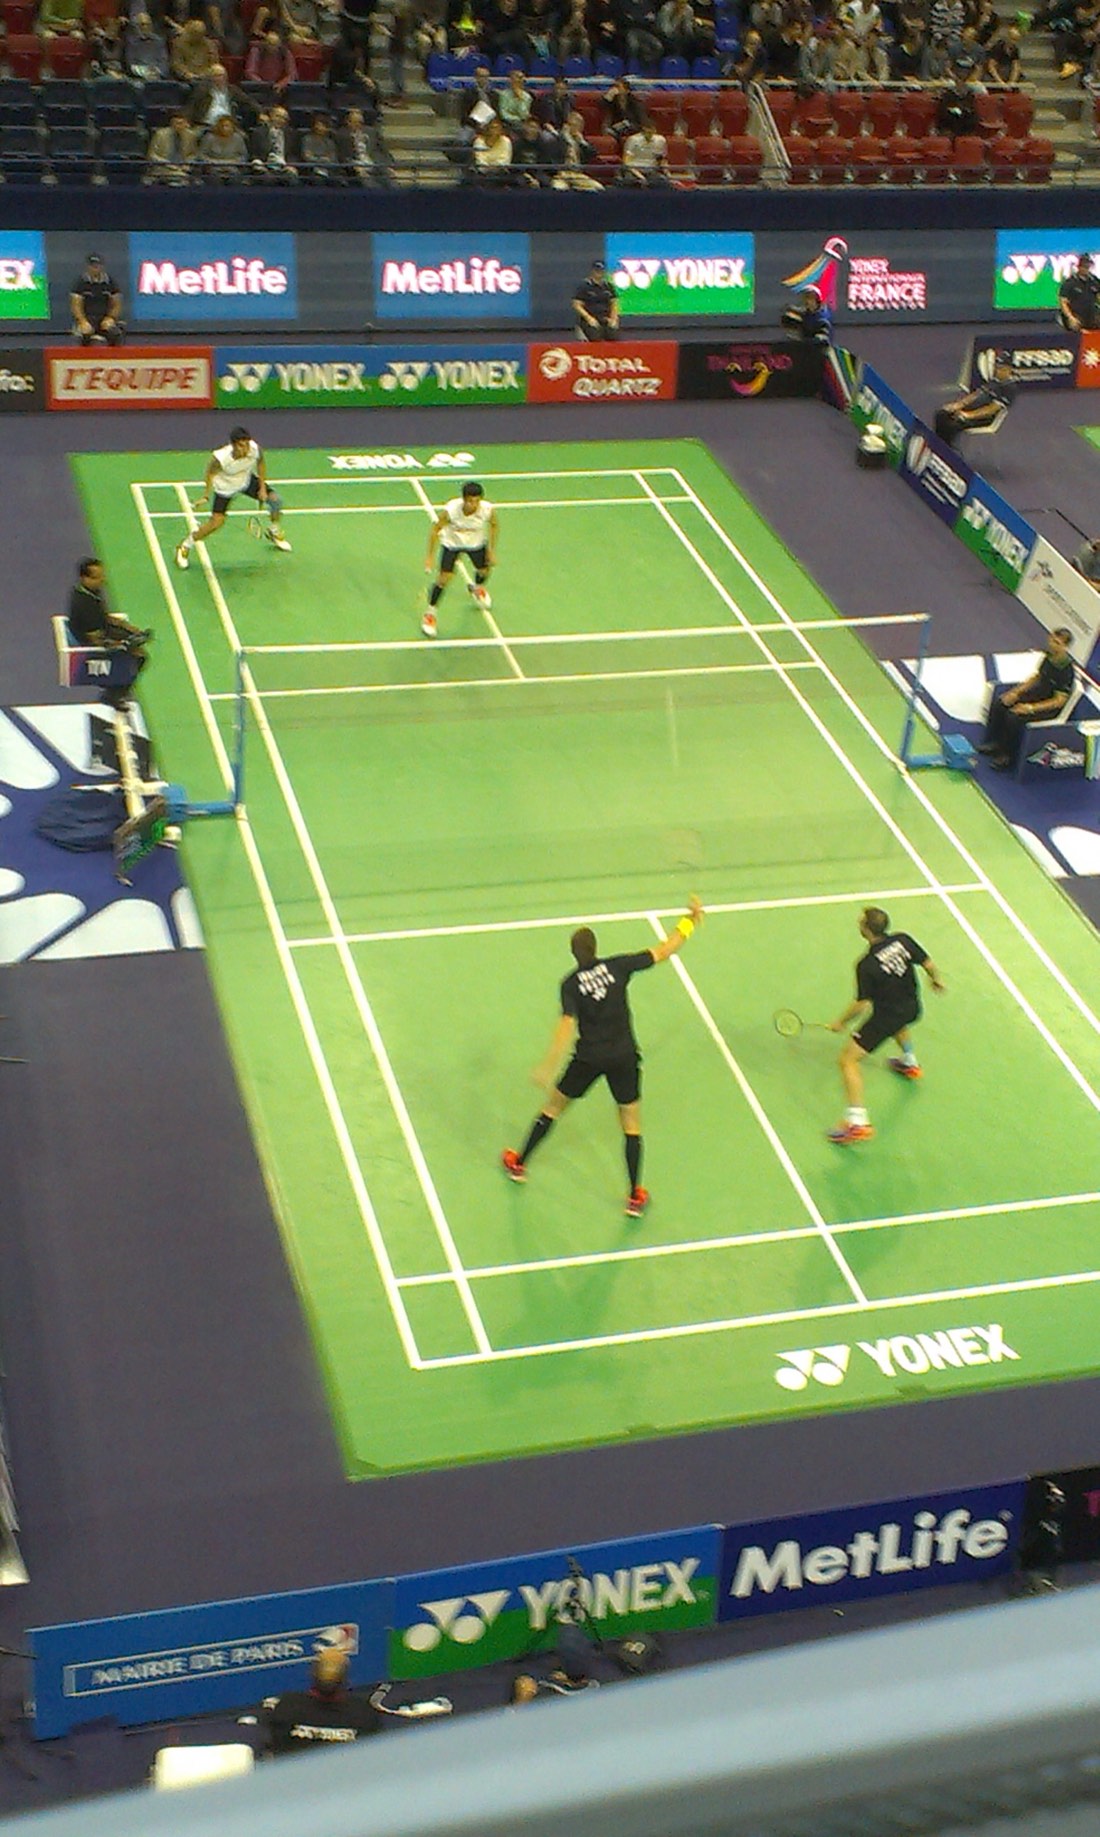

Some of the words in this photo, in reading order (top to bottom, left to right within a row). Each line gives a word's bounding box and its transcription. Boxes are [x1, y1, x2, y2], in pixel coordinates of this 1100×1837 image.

[139, 257, 287, 294] MetLife
[382, 257, 521, 294] MetLife
[664, 259, 746, 288] YONEX
[848, 284, 926, 302] FRANCE
[276, 362, 366, 391] YONEX
[433, 361, 519, 389] YONEX
[574, 355, 650, 373] TOTAL
[572, 377, 662, 397] QUARTZ
[856, 1324, 1021, 1377] YONEX
[730, 1508, 1008, 1599] MetLife
[518, 1556, 700, 1631] YONEX
